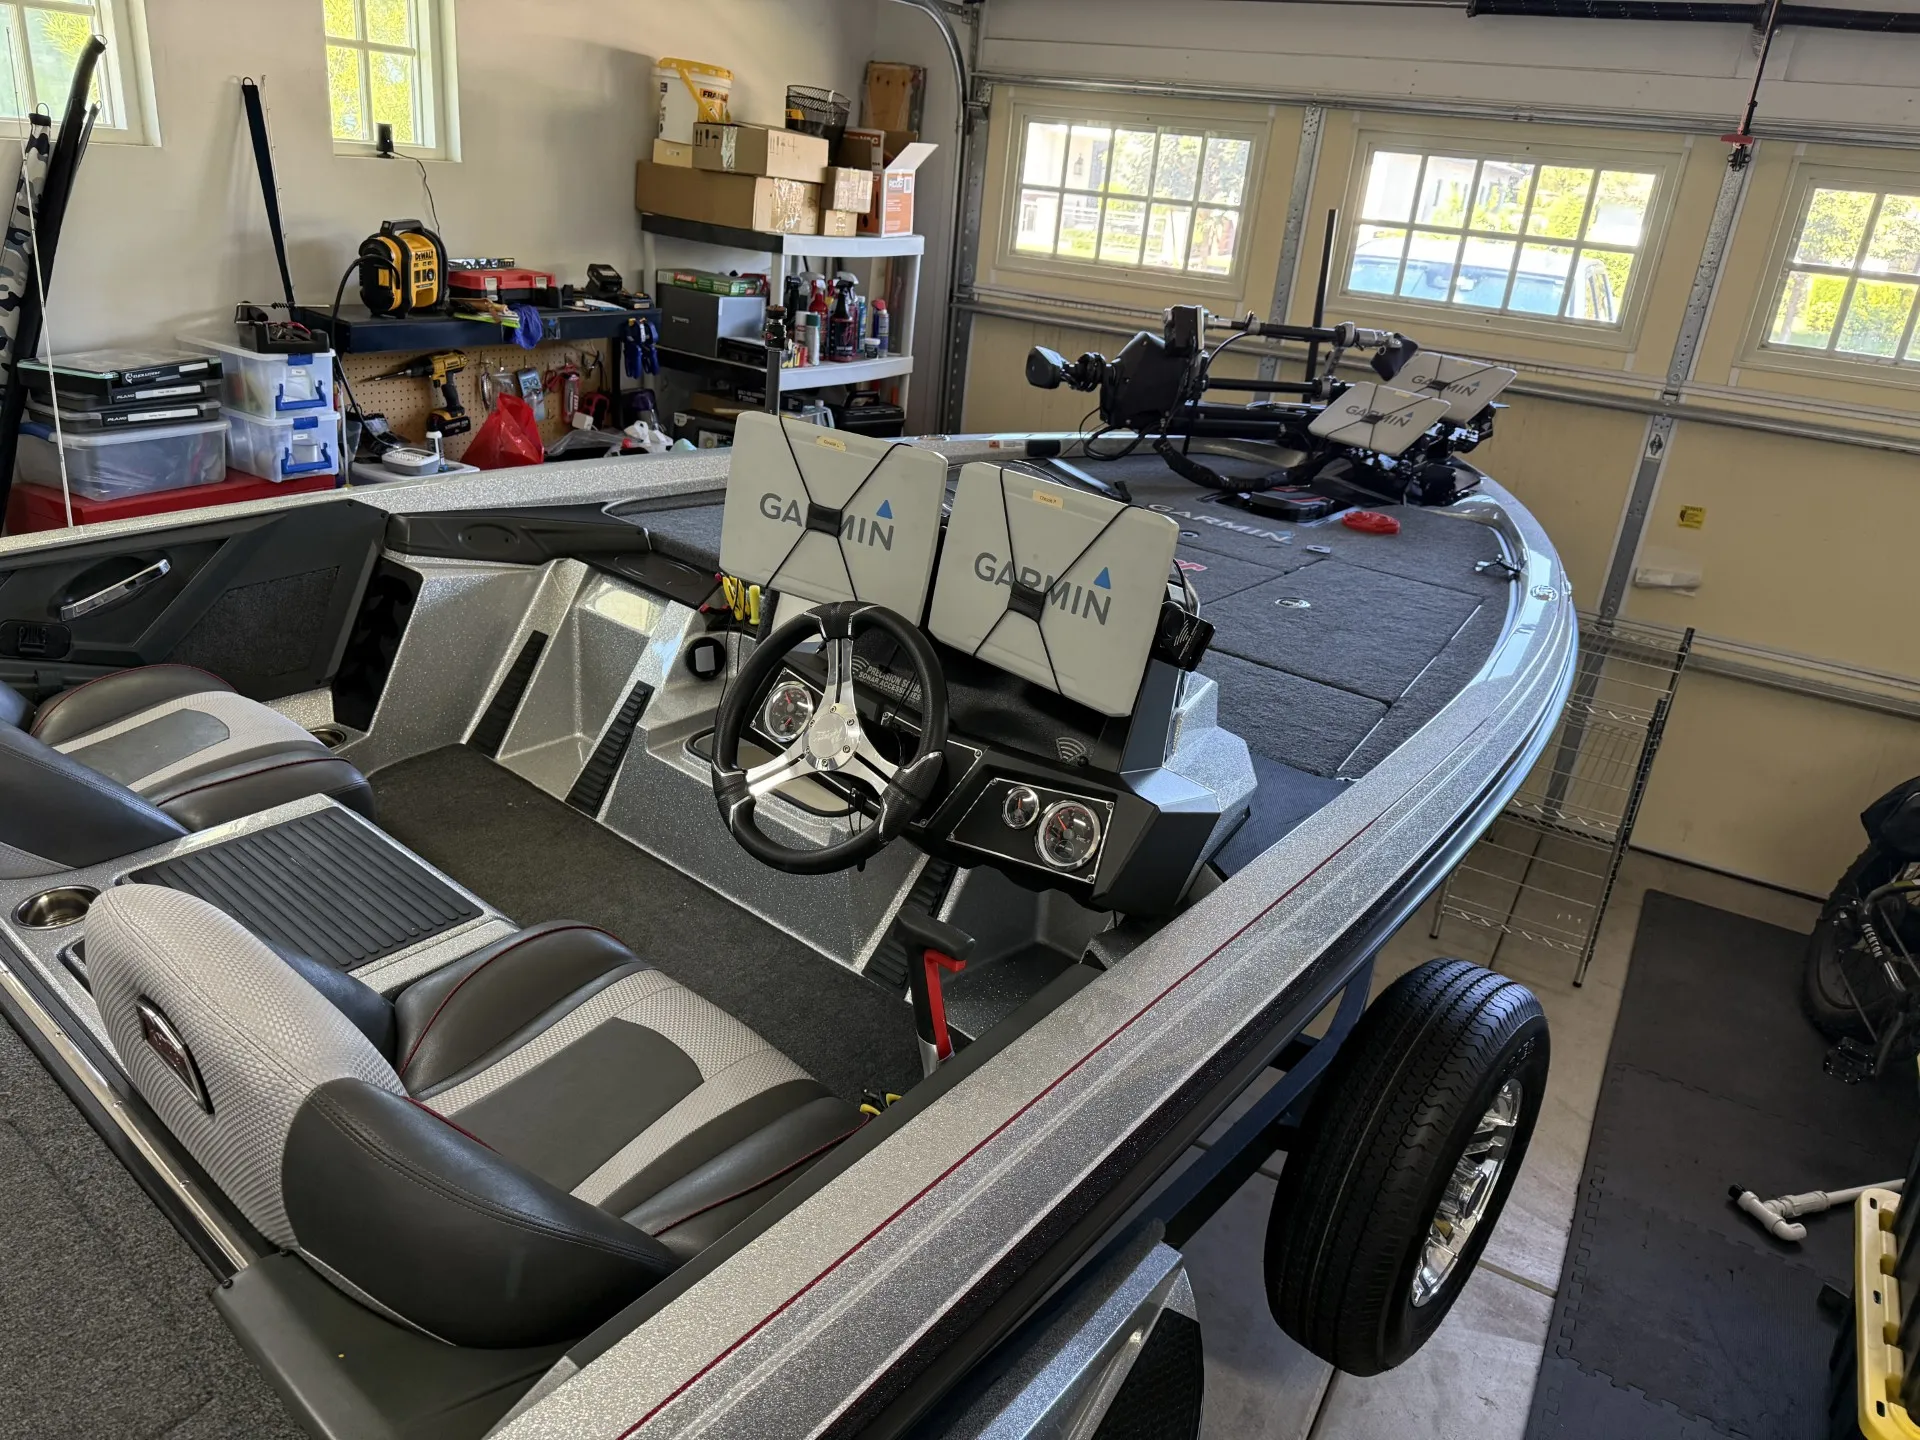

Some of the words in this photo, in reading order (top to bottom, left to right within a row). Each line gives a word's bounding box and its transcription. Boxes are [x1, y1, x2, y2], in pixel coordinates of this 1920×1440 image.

[1411, 375, 1477, 397] GAMIN
[1345, 405, 1411, 428] GAMIN
[759, 492, 895, 552] GAMIN
[1147, 503, 1291, 543] GARMIN
[1860, 923, 1884, 958] AVENTON
